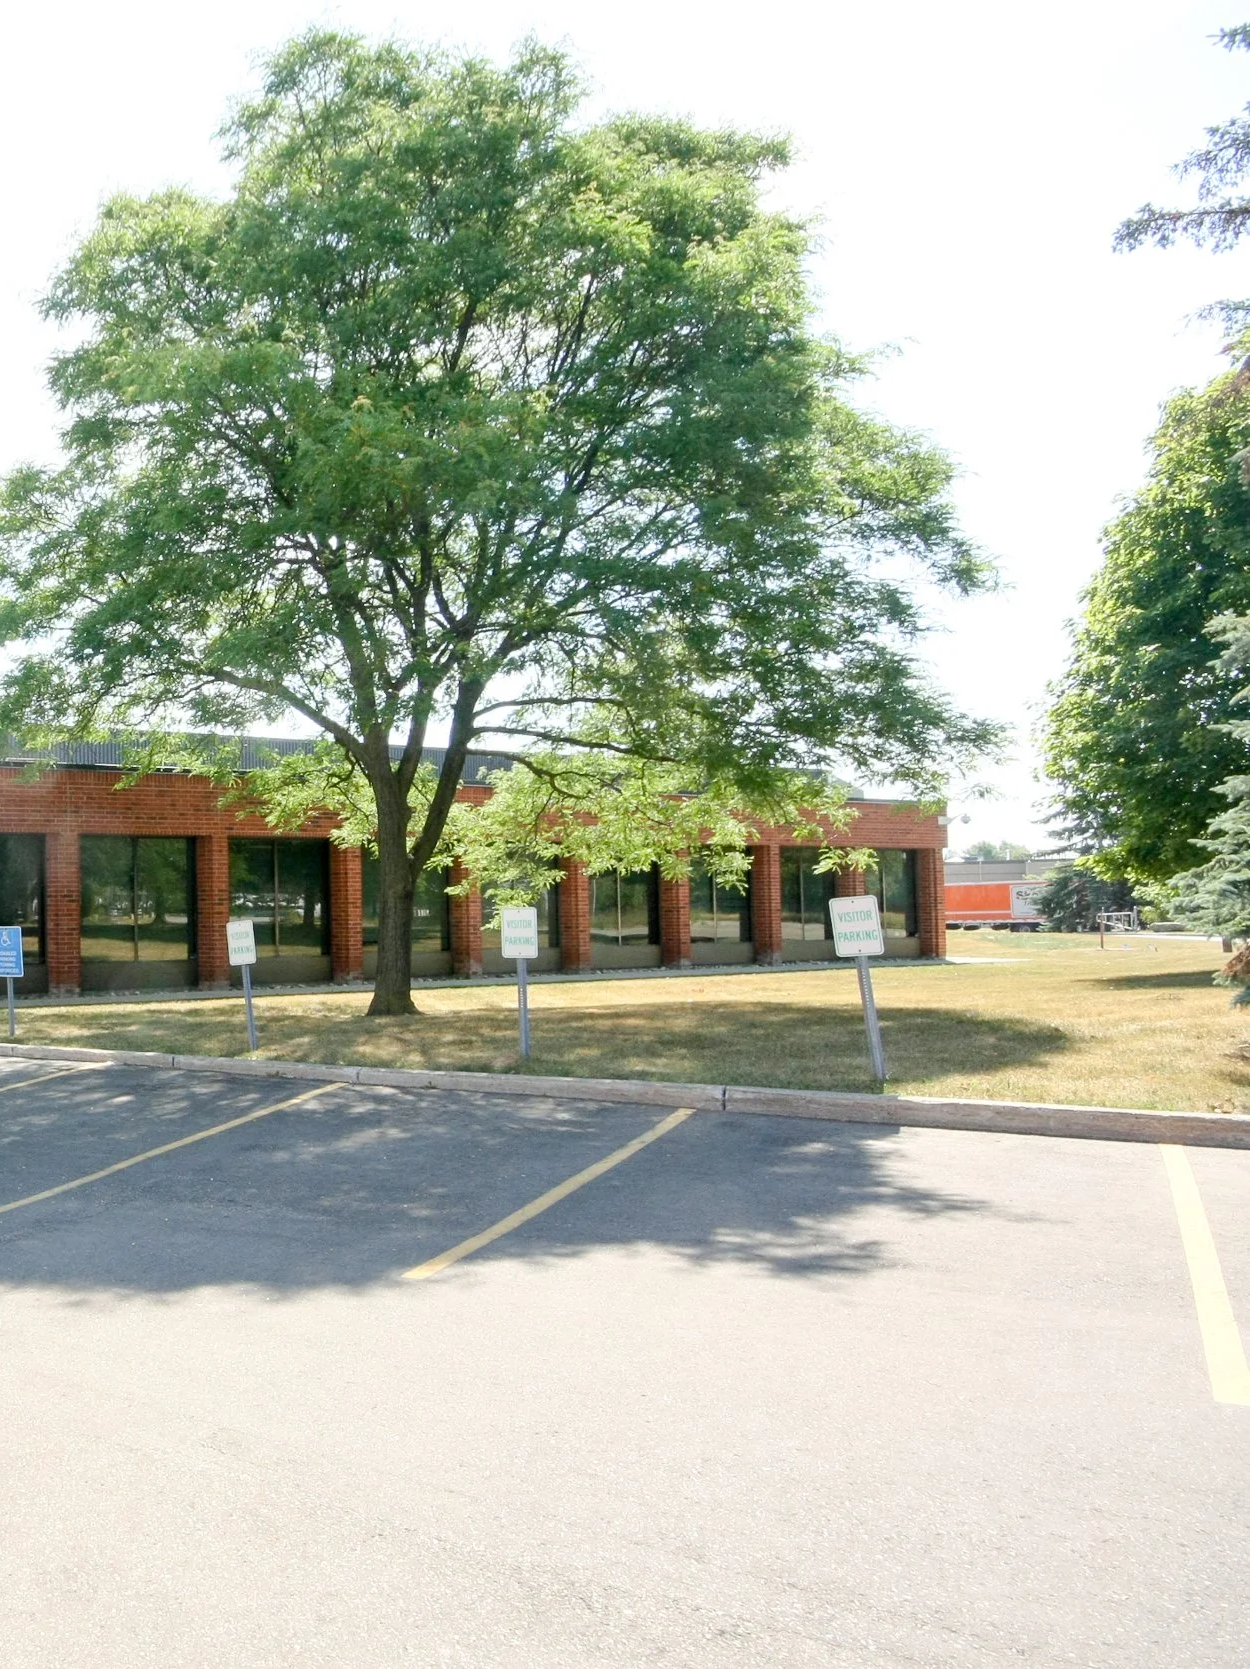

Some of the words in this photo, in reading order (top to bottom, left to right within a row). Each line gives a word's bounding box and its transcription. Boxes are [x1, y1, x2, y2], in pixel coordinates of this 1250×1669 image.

[837, 910, 873, 922] VISITOR
[506, 919, 534, 929] VISITOR
[505, 936, 535, 945] PARKING
[837, 930, 878, 942] PARKING
